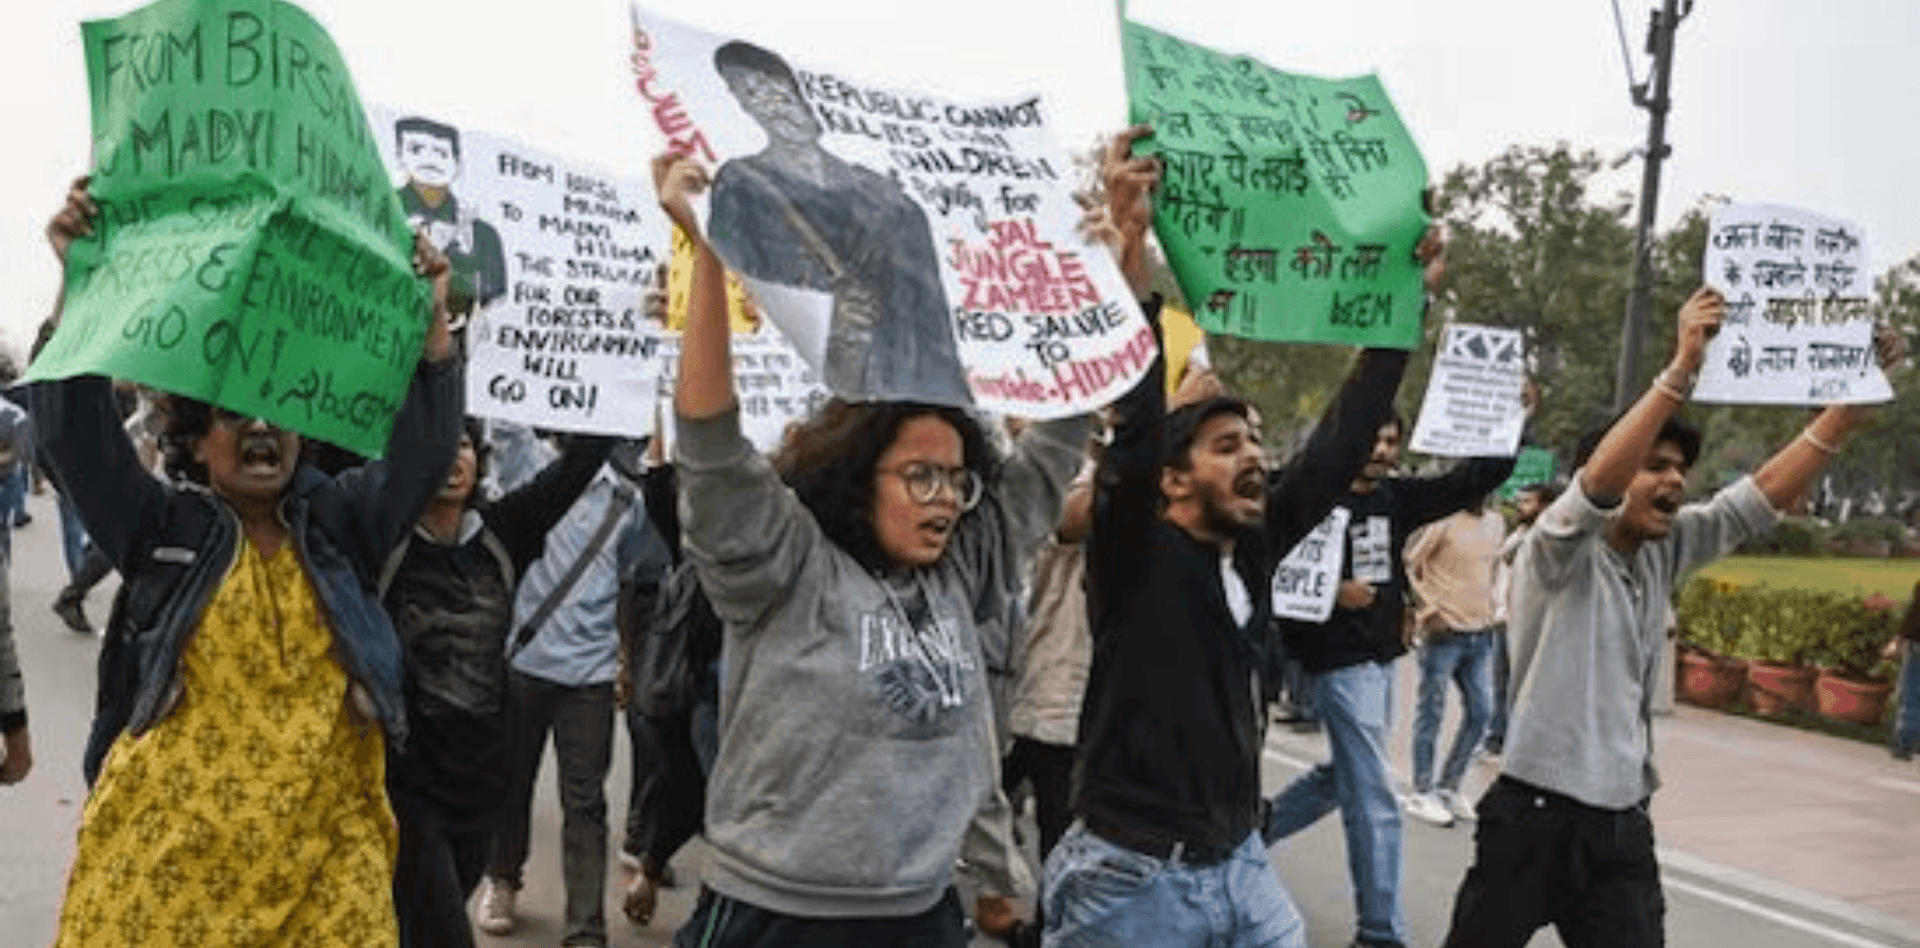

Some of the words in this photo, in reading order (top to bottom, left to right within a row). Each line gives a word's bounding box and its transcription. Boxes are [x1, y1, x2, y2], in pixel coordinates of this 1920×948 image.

[99, 20, 204, 106] FROM
[224, 10, 366, 150] BIRSA
[985, 217, 1054, 251] JAL
[947, 239, 1086, 284] JUNGLE
[955, 306, 1014, 342] RED
[524, 353, 581, 381] WILL
[1024, 341, 1071, 369] TO
[488, 374, 526, 403] GO
